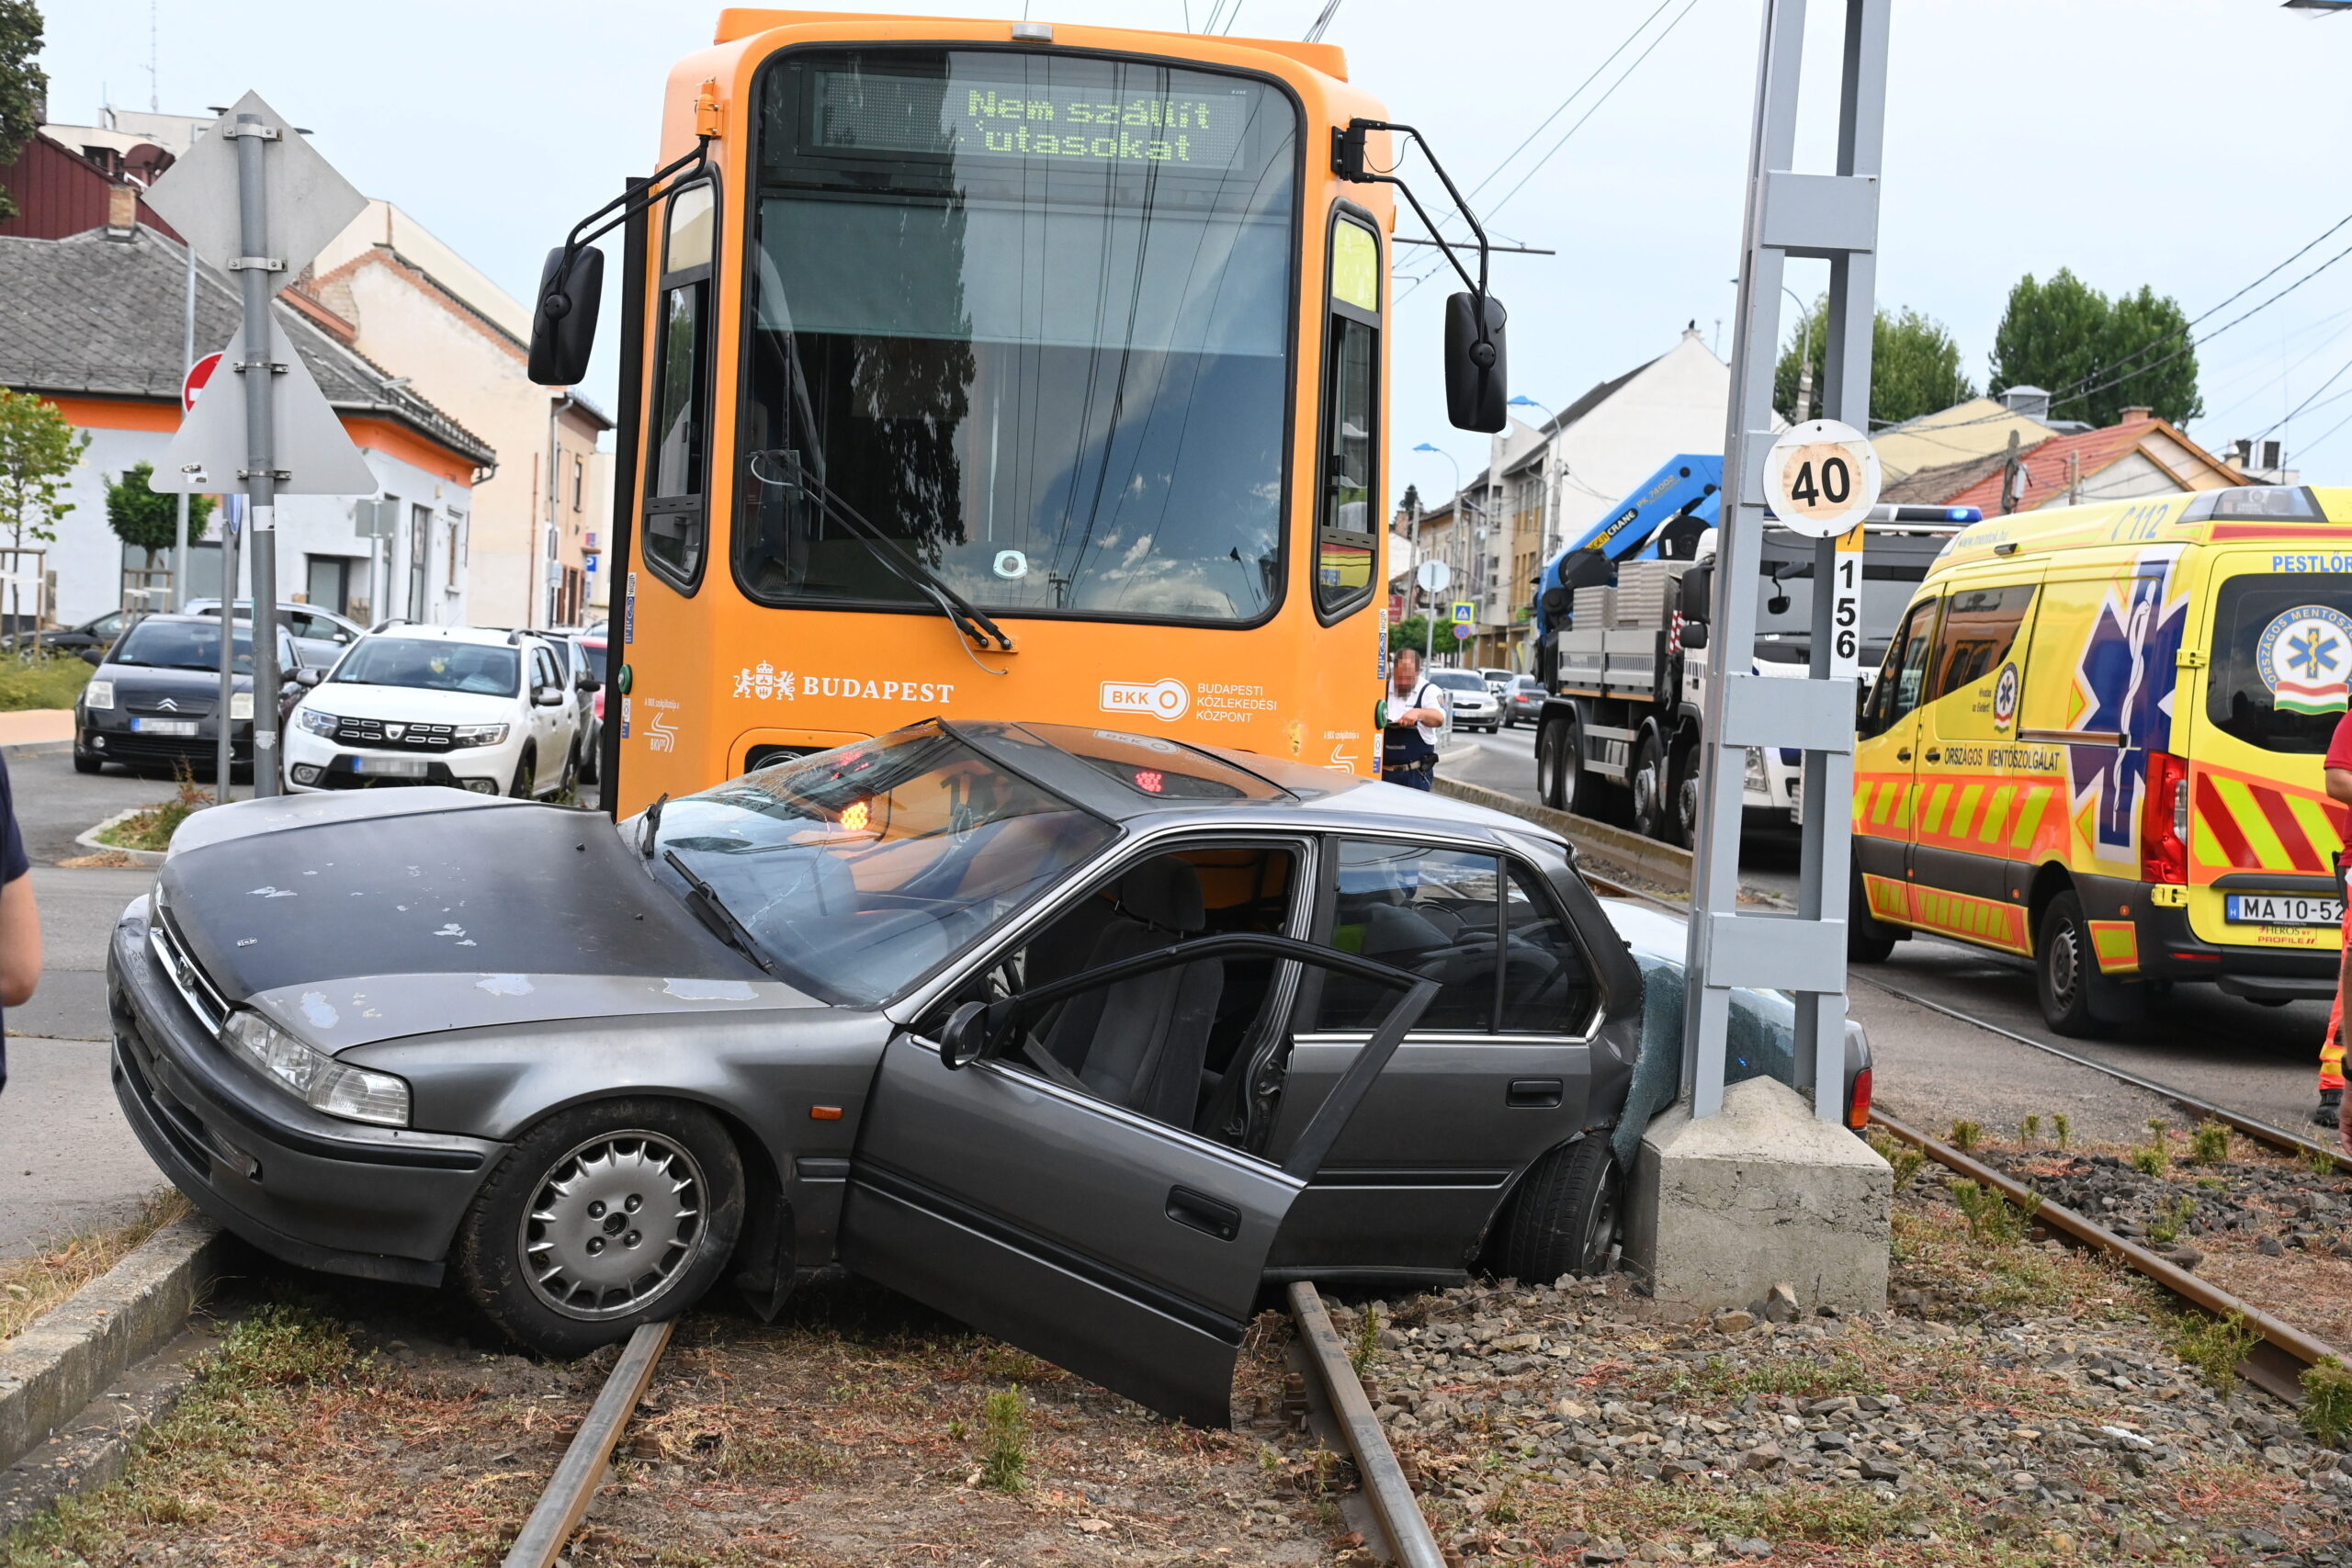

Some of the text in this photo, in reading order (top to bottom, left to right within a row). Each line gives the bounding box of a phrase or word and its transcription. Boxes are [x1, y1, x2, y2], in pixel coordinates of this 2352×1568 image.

[968, 90, 1210, 130] Nem szállít
[986, 125, 1191, 162] utasokat
[1791, 457, 1851, 507] 40
[1607, 510, 1636, 536] CRANE
[2129, 503, 2169, 540] 112
[2261, 616, 2289, 684] ORSZÁGOS
[802, 676, 955, 704] BUDAPEST
[1112, 690, 1149, 705] BKK
[1197, 682, 1263, 696] BUDAPESTI
[1196, 695, 1277, 712] KÖZLEKEDÉSI
[1196, 709, 1253, 723] KÖZPONT
[1944, 744, 2060, 772] ORSZÁGOS MENTŐSZOLGÁLAT
[2245, 898, 2276, 919] MA
